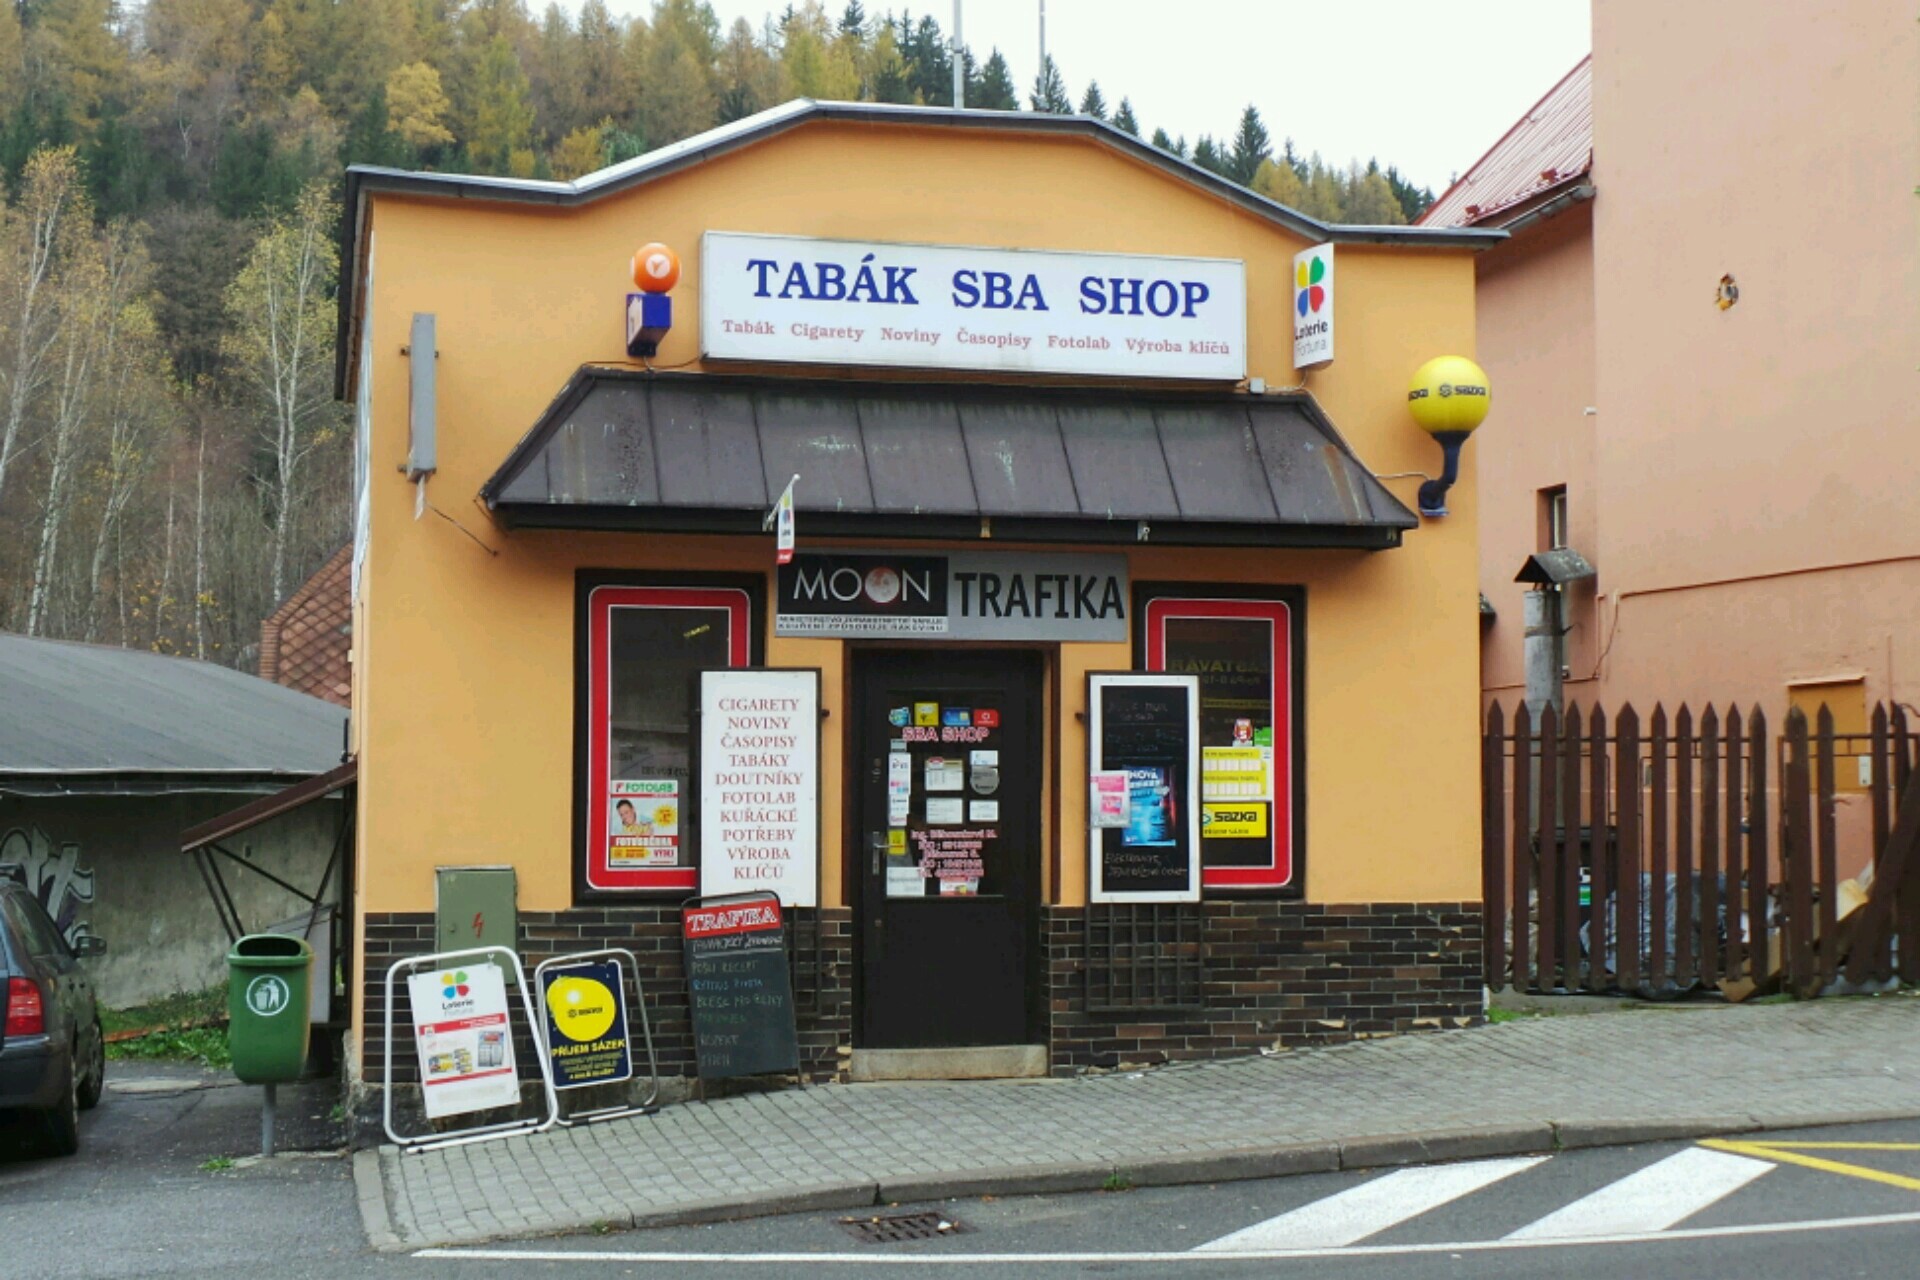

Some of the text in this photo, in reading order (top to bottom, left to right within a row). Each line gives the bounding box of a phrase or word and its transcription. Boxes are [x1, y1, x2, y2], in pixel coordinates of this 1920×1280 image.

[747, 253, 1210, 318] TABÁK SBA SHOP
[723, 319, 775, 335] Tabák
[790, 323, 864, 340] Cigarety
[881, 327, 941, 345] Noviny
[957, 328, 1032, 350] Časopisy
[1048, 335, 1110, 350] Fotolab
[1125, 337, 1182, 355] Výroba
[955, 571, 1125, 619] TRAFIKA
[718, 698, 800, 712] CIGARETY
[728, 716, 791, 730] NOVINY
[720, 732, 797, 748] ČASOPISY
[902, 727, 989, 742] SBA SHOP
[729, 751, 790, 767] TABÁKY
[715, 770, 803, 785] DOUTNÍKY
[626, 783, 674, 793] FOTOLAB
[721, 791, 796, 804] FOTOLAB
[720, 808, 798, 823] KUŘÁCKÉ
[722, 826, 796, 842] POTŘEBY
[727, 844, 791, 860] VÝROBA
[733, 861, 783, 879] KLÍČŮ
[687, 906, 778, 932] TRAFIKA
[591, 1038, 626, 1053] SÁZEK
